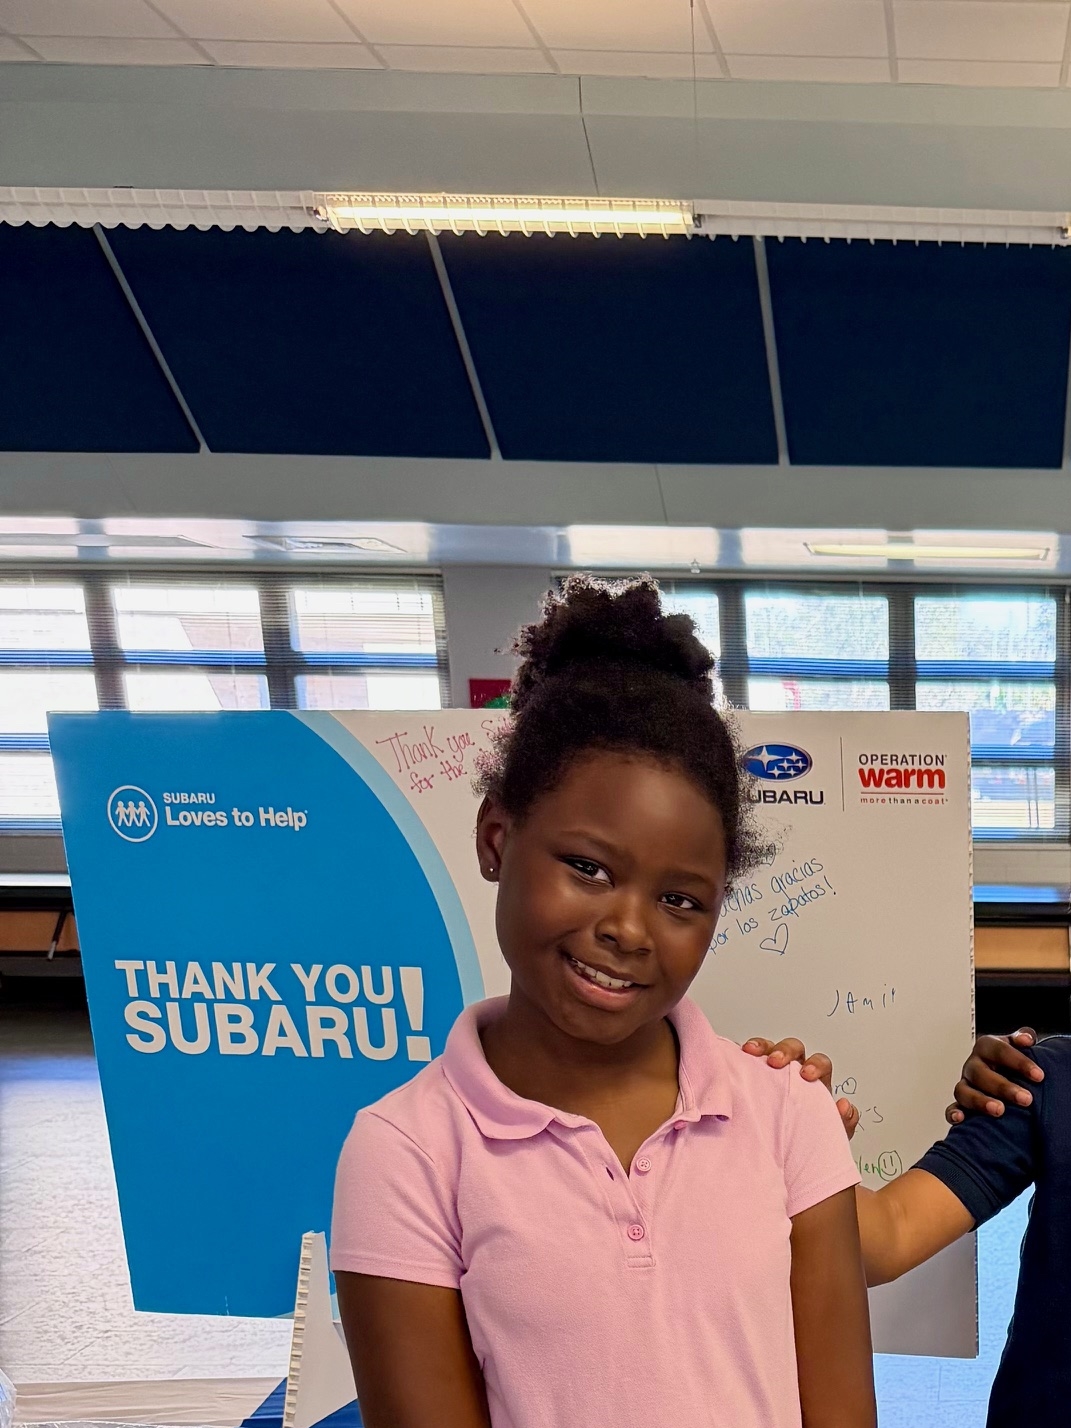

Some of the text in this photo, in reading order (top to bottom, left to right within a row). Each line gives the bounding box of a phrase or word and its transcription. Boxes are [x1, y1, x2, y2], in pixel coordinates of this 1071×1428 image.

[376, 725, 444, 772] Thank
[446, 732, 475, 762] you
[858, 753, 945, 766] OPERATION
[410, 771, 434, 793] for
[440, 760, 467, 780] the
[858, 768, 946, 789] warm
[163, 792, 215, 804] SUBARU
[753, 790, 824, 805] UBARU
[860, 797, 886, 805] more
[889, 797, 912, 805] than
[922, 797, 945, 805] coat
[165, 806, 307, 831] Loves to Help
[720, 858, 824, 918] uchas gracias
[115, 960, 395, 1004] THANK YOU
[124, 967, 432, 1062] SUBARU!
